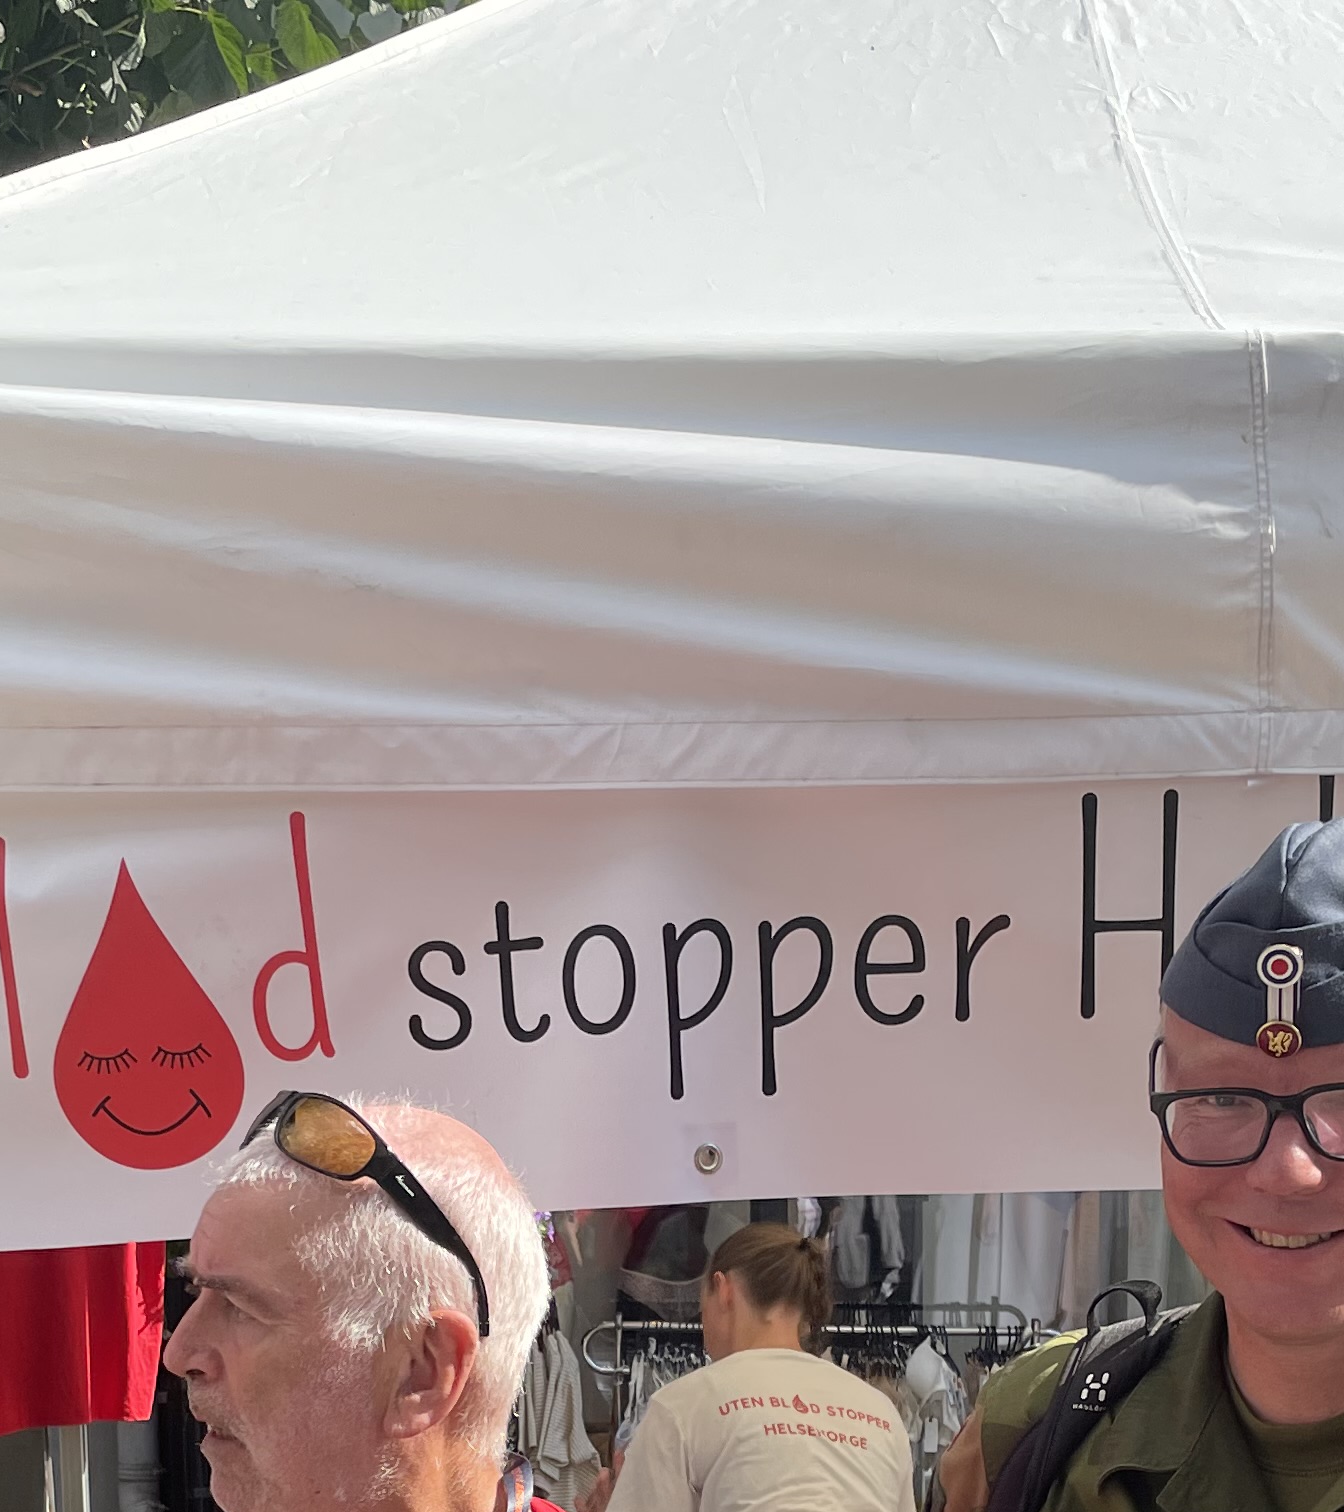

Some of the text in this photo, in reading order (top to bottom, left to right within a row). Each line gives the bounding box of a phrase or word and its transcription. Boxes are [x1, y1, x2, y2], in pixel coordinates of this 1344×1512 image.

[408, 902, 1010, 1100] stopper
[718, 1396, 764, 1416] UTEN
[826, 1405, 891, 1432] STOPPER
